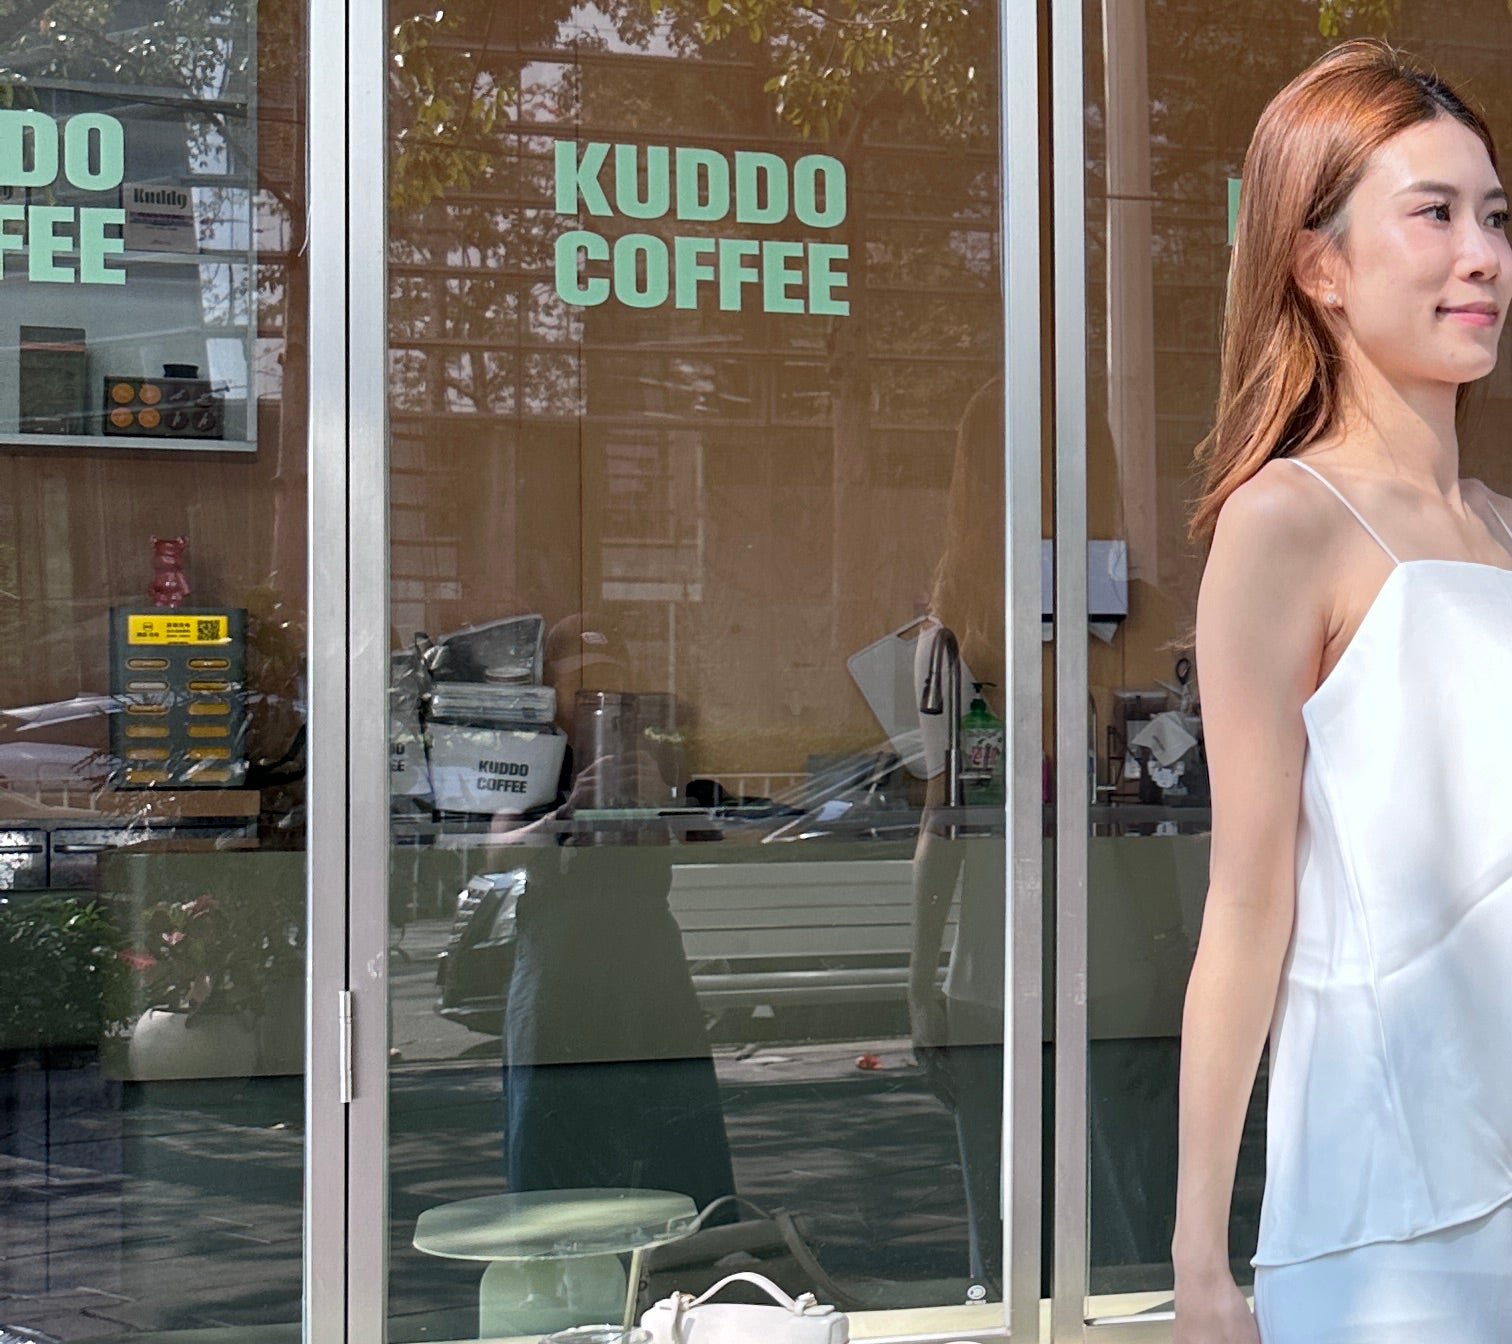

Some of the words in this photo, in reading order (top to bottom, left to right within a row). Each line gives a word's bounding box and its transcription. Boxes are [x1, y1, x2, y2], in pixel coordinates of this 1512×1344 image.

[554, 140, 847, 228] KUDDO
[555, 230, 850, 316] COFFEE
[476, 777, 528, 794] COFFEE
[478, 759, 529, 777] KUDDO
